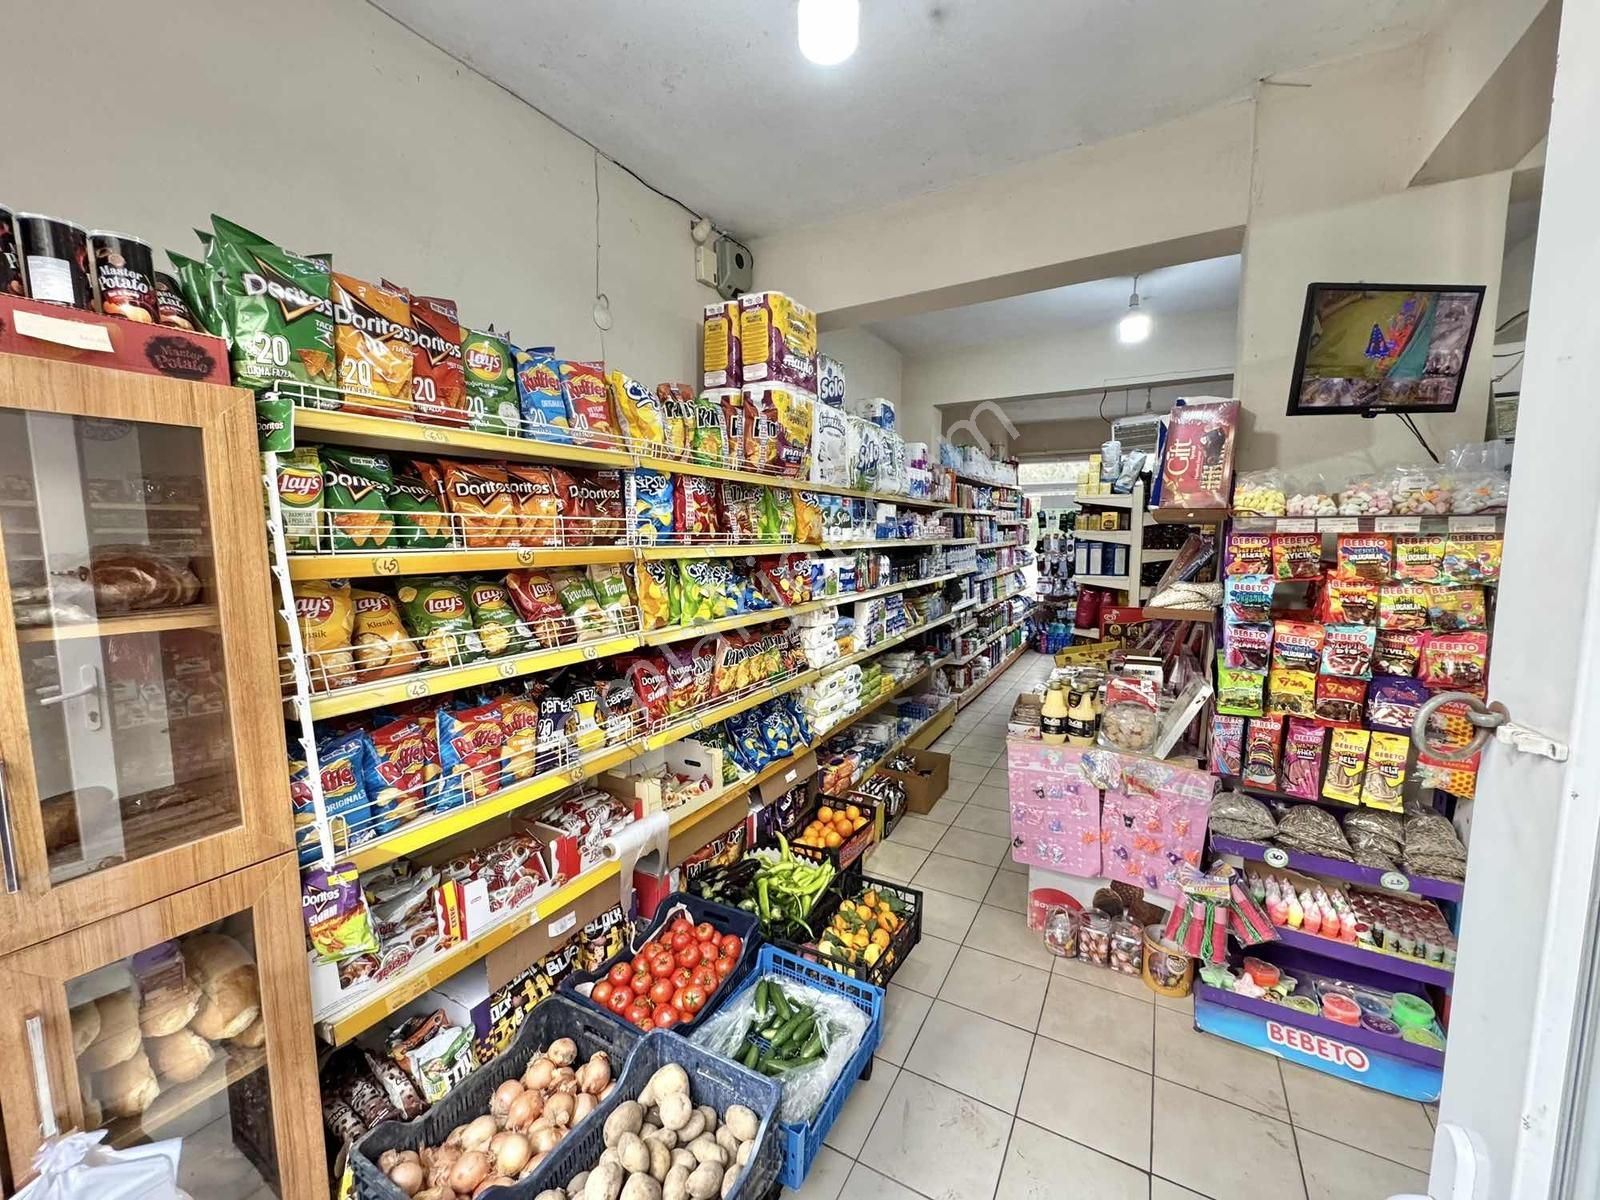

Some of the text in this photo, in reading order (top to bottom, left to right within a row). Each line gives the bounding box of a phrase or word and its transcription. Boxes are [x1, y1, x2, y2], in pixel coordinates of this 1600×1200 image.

[100, 266, 143, 280] Master
[99, 275, 149, 294] Potato
[242, 272, 334, 317] Doritos
[334, 303, 411, 343] Doritos
[467, 348, 502, 374] Lay's
[413, 377, 436, 402] 20
[568, 379, 606, 399] Ruffles
[1167, 438, 1191, 476] Gift
[281, 475, 320, 495] Lay's
[325, 471, 390, 494] Doritos
[1232, 537, 1270, 545] BEBETO
[1278, 536, 1317, 544] BEBETO
[1344, 539, 1386, 548] BEBETO
[1397, 537, 1441, 545] BEBETO
[1234, 584, 1269, 592] BEBETO
[295, 597, 331, 618] ay's
[428, 597, 464, 615] Lay's
[367, 619, 395, 629] Klasik
[1233, 630, 1267, 638] BEBETO
[1280, 635, 1318, 647] BEBETO
[1431, 642, 1477, 651] BEBETO
[1334, 742, 1364, 752] BEBETO
[1339, 756, 1358, 766] BELT
[1374, 751, 1405, 761] BEBETO
[1380, 766, 1399, 775] BELT
[303, 889, 340, 907] Doritos
[1268, 1021, 1368, 1070] BEBETO
